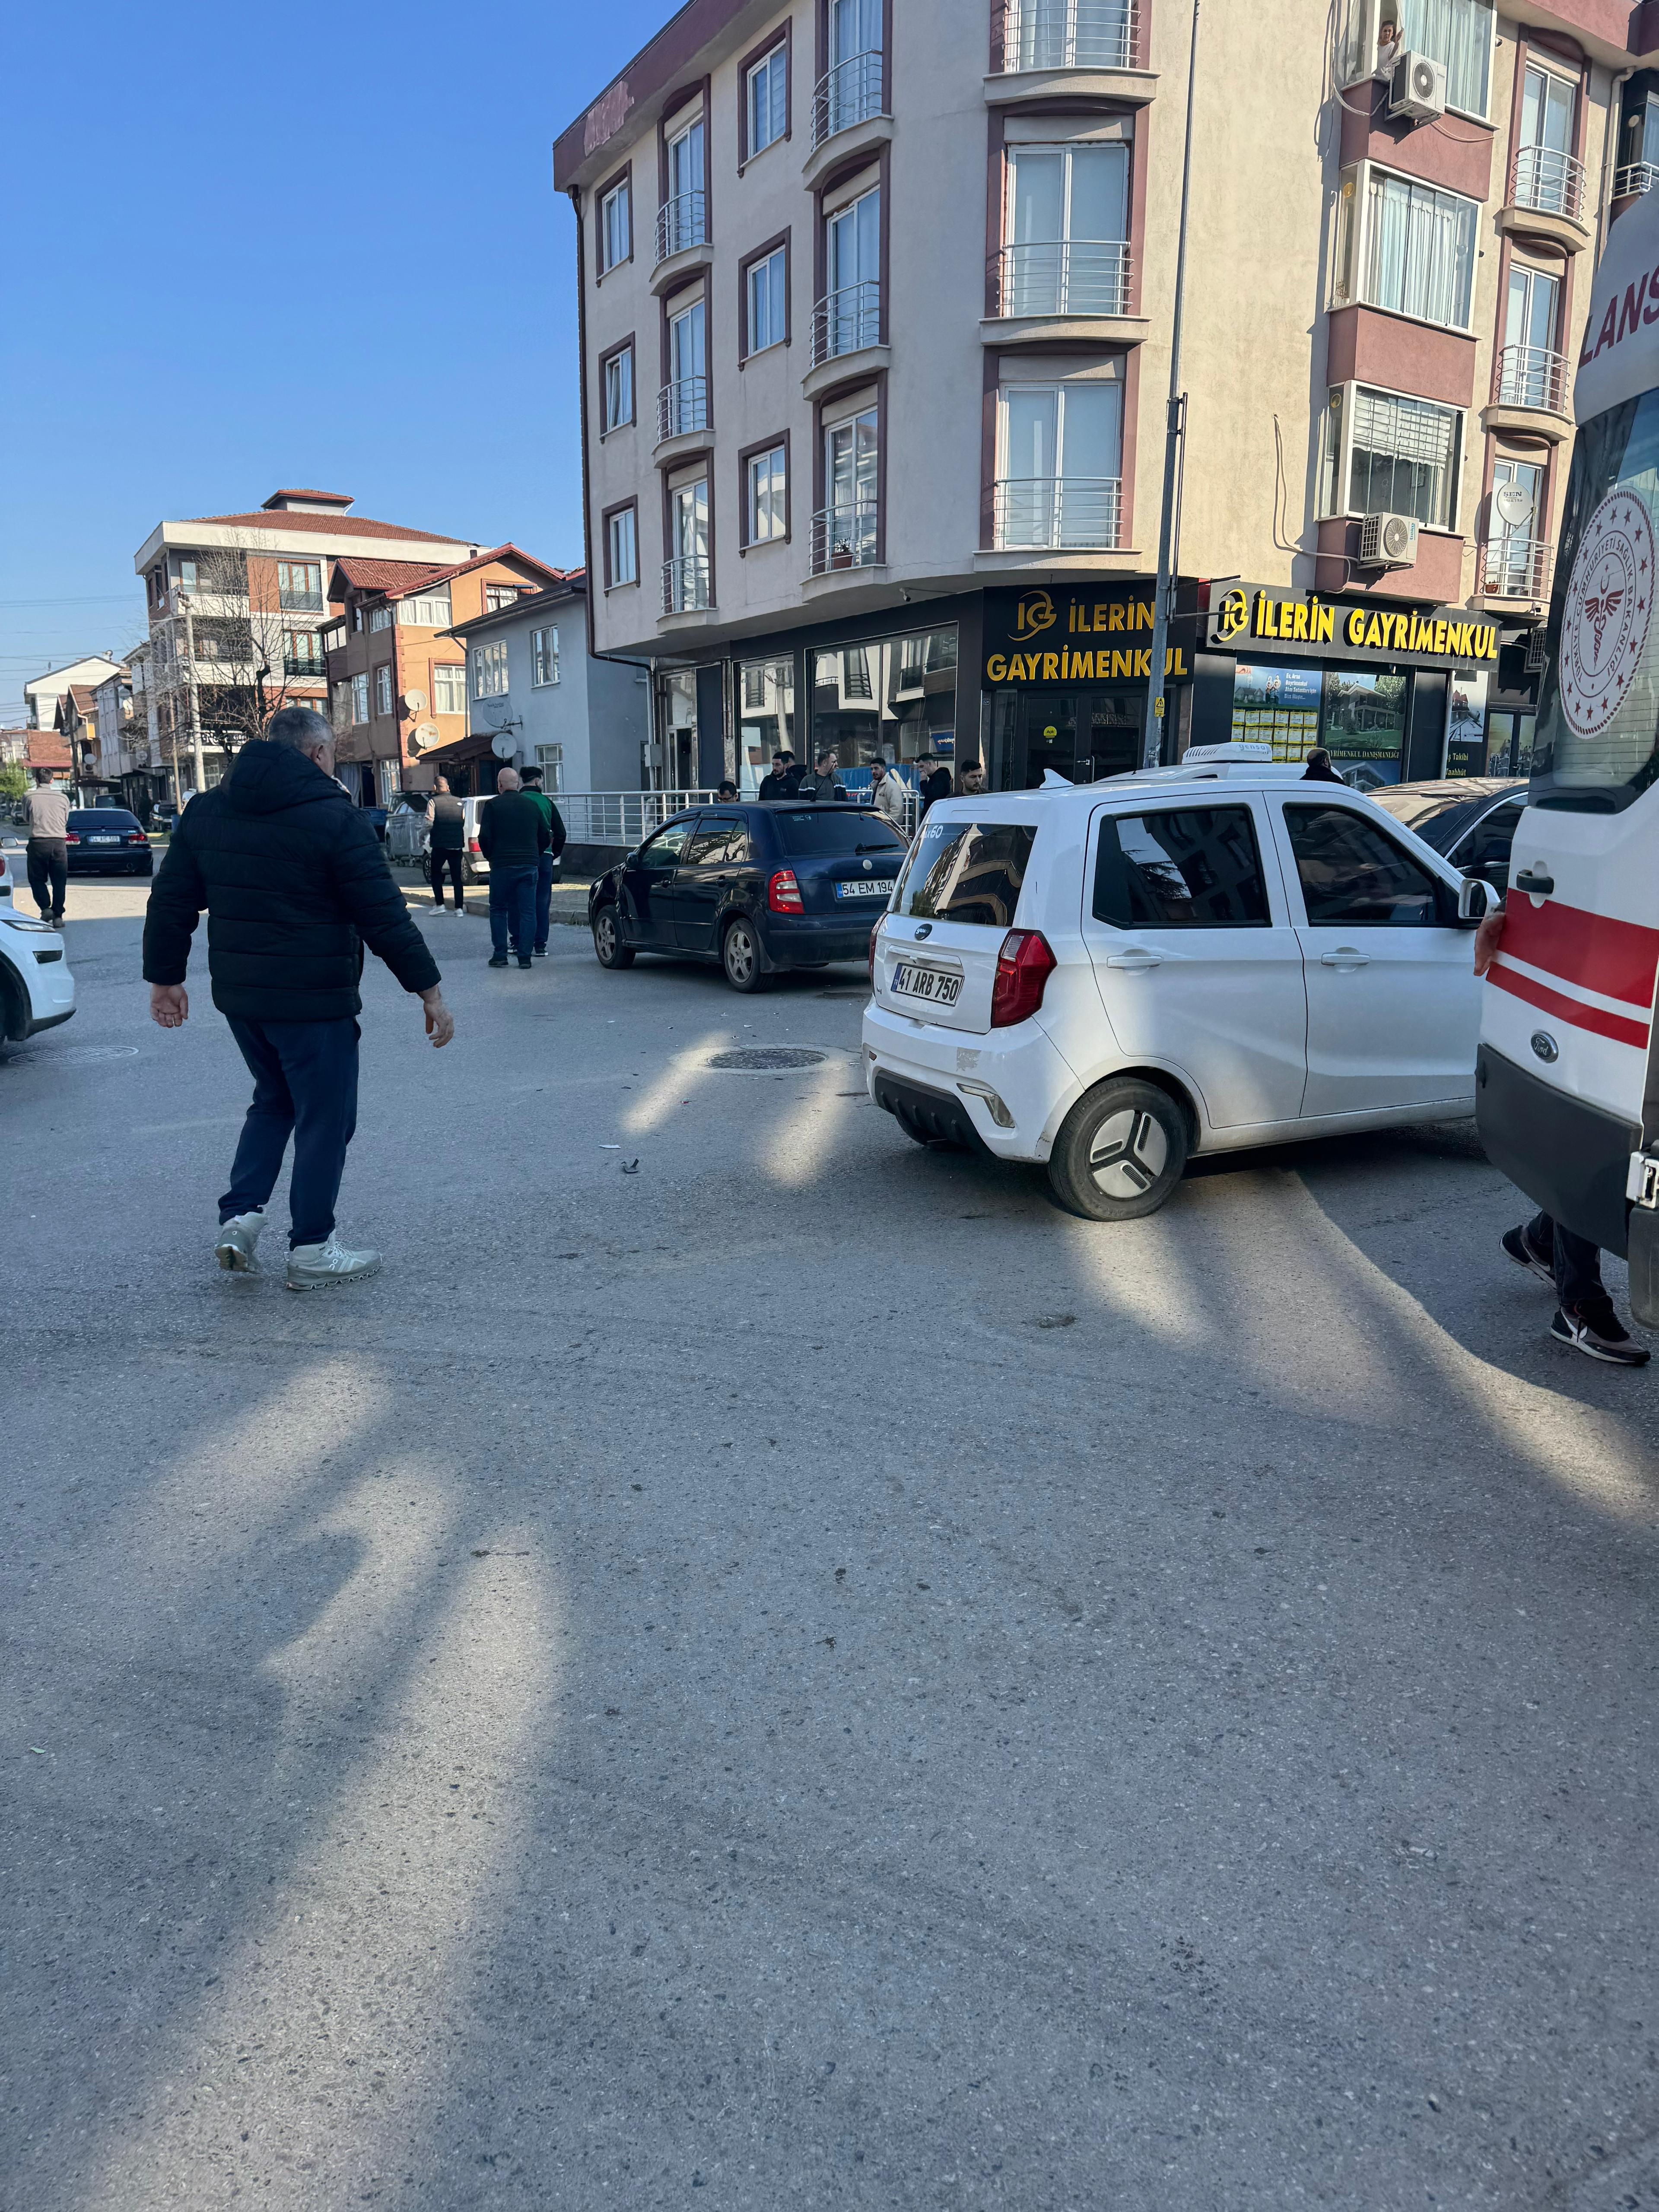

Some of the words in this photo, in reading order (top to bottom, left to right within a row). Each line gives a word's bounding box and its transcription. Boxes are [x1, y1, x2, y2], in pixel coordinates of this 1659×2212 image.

[1577, 536, 1616, 617] CUMHURİYETİ
[1616, 539, 1633, 581] SAĞLIK
[1069, 595, 1155, 632] İLERİN
[1256, 590, 1335, 642] İLERİN
[1349, 608, 1497, 659] GAYRİMENKUL
[1607, 585, 1633, 677] BAKANLIĞI
[1329, 748, 1361, 757] YRİMENKUL
[842, 883, 855, 895] 54
[858, 882, 875, 894] EM
[877, 881, 893, 893] 194
[899, 968, 912, 991] 41
[912, 971, 934, 995] ARB
[934, 976, 959, 1001] 750
